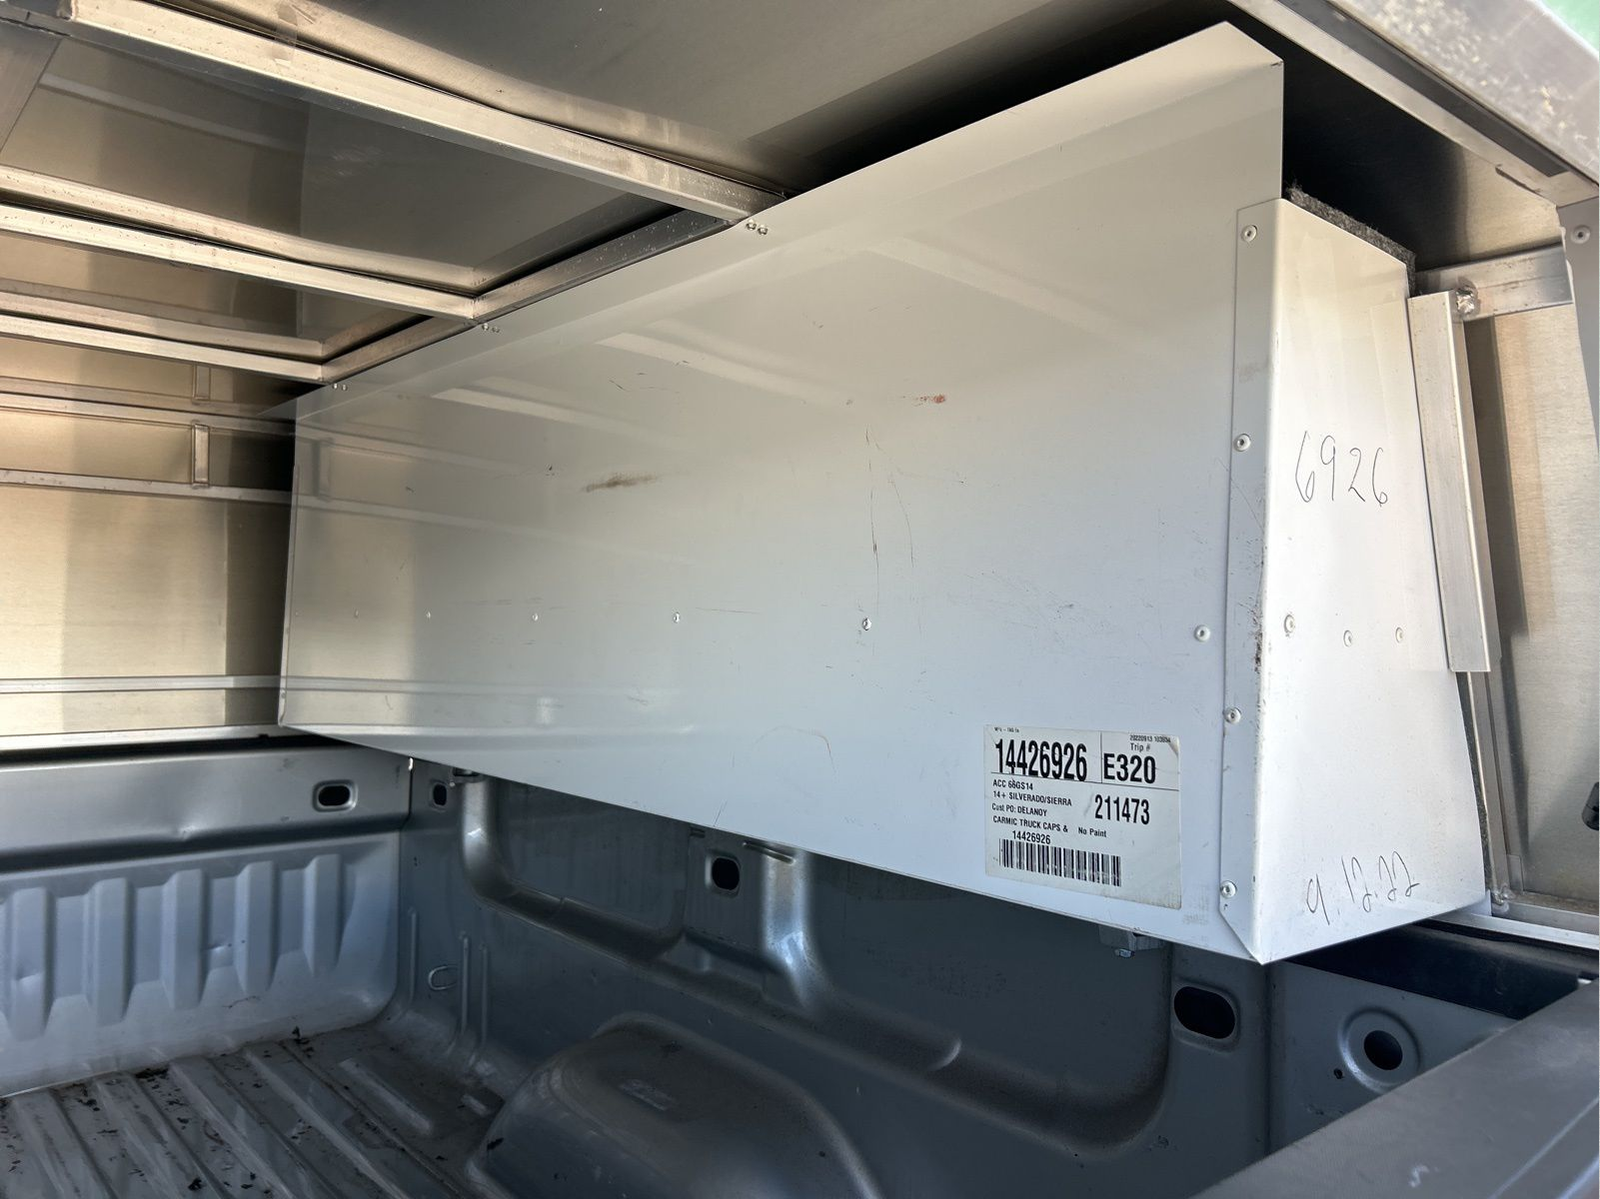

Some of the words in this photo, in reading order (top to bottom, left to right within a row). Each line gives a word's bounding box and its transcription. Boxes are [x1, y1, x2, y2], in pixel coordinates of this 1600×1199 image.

[1295, 431, 1388, 507] 6926
[1130, 742, 1144, 753] Trip
[995, 738, 1087, 782] 14426926
[1103, 752, 1156, 784] E320
[992, 779, 1006, 788] ACC
[1008, 791, 1073, 807] SILVERADO/SIERRA
[991, 803, 1005, 812] Cust
[1006, 804, 1016, 813] PO:
[1094, 793, 1150, 826] 211473
[992, 815, 1018, 826] CARMIC
[1019, 818, 1042, 829] TRUCK
[1042, 821, 1061, 832] CAPS
[1062, 824, 1069, 833] &
[1077, 826, 1088, 836] No
[1089, 827, 1107, 838] Paint
[1012, 830, 1051, 845] 14426926
